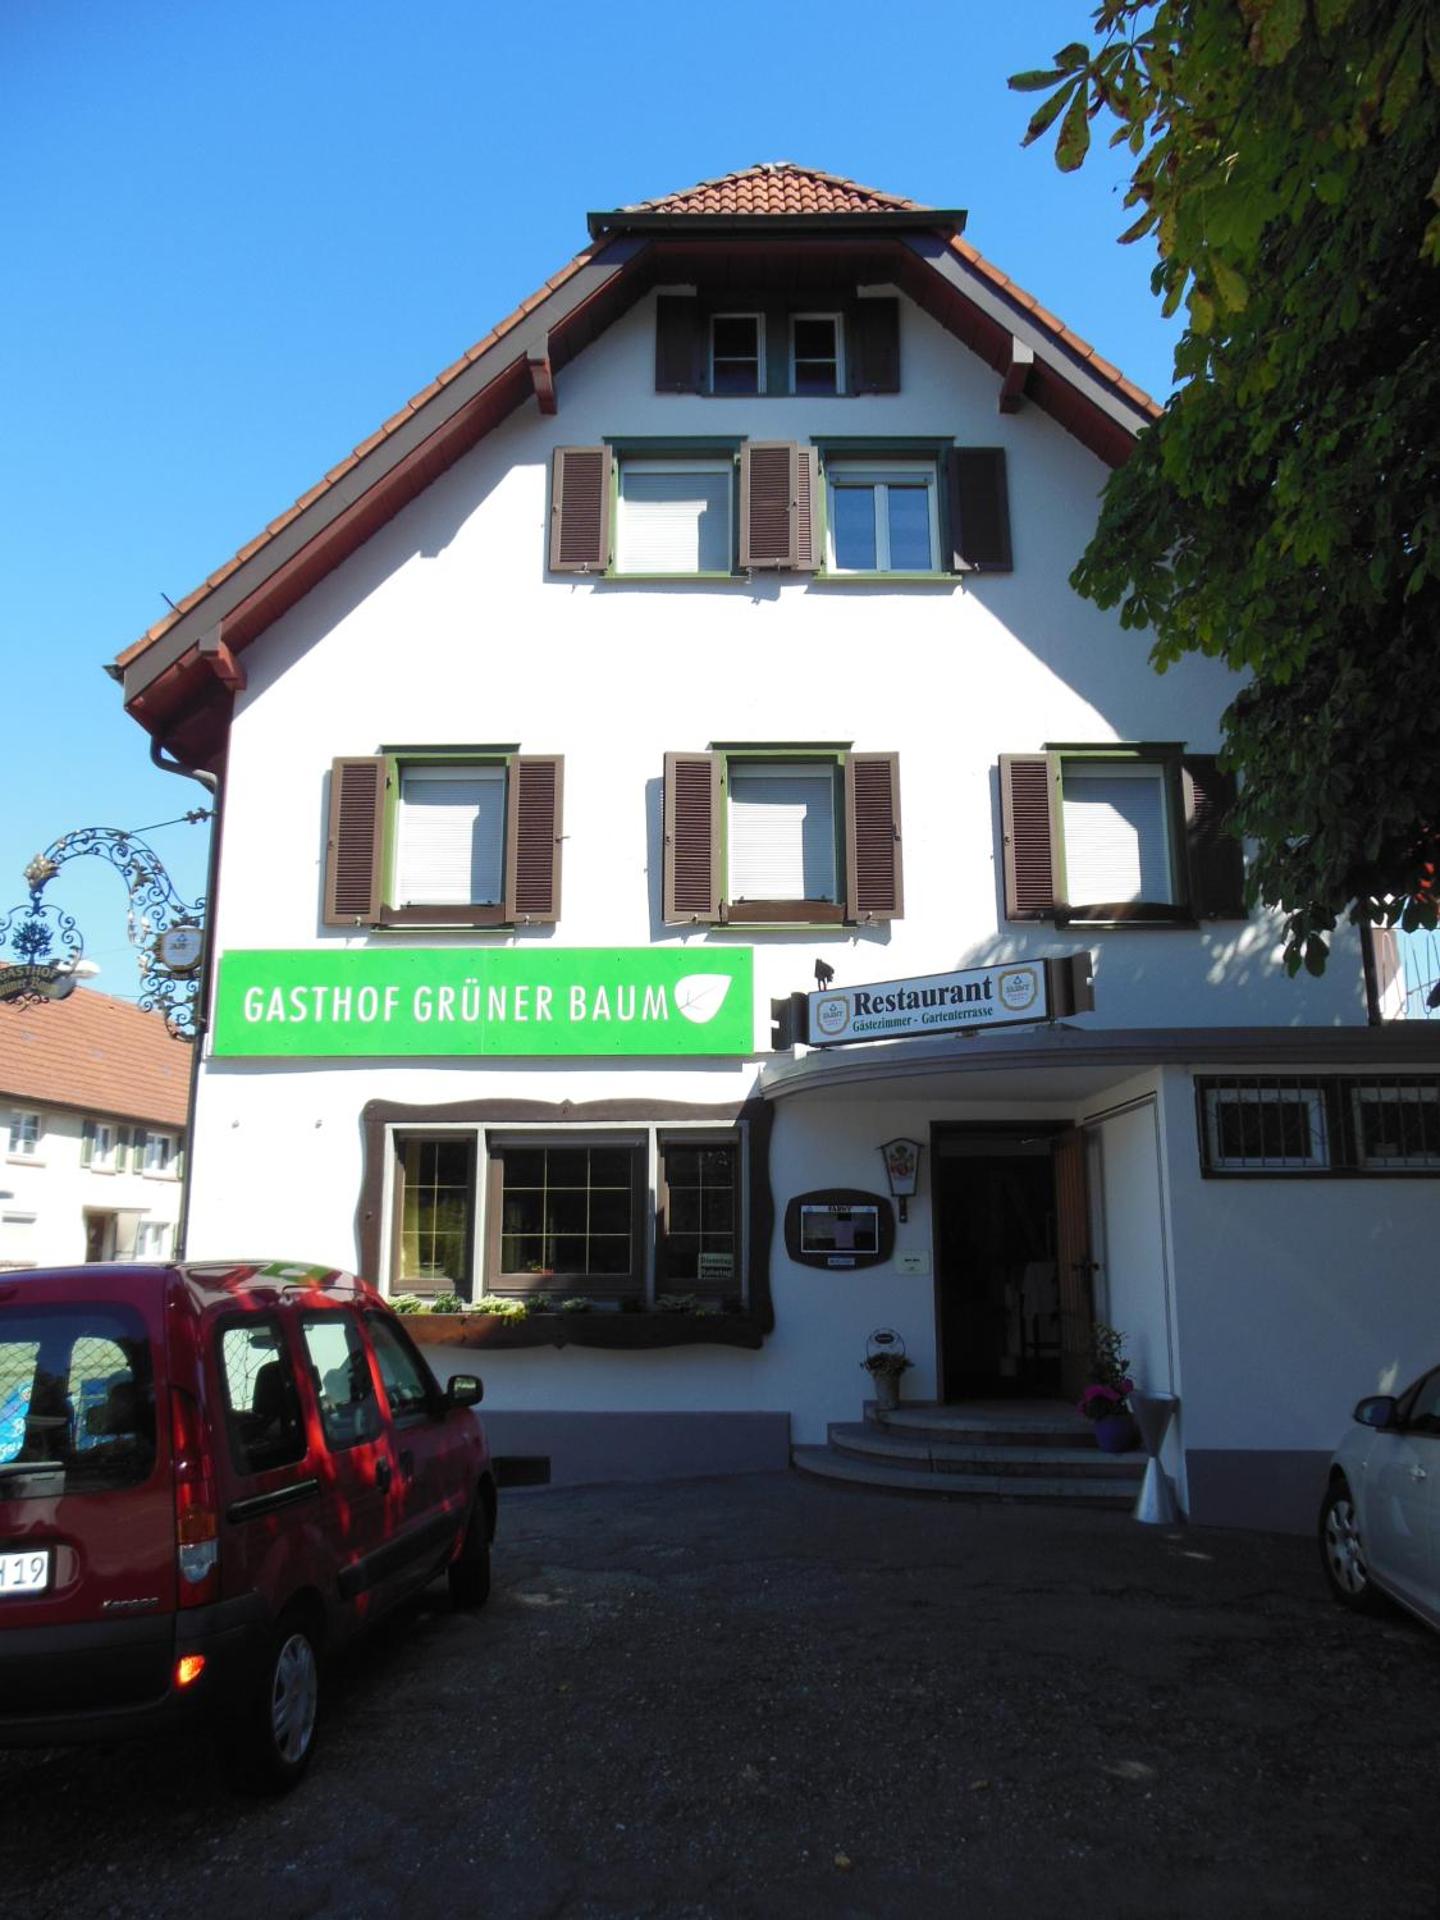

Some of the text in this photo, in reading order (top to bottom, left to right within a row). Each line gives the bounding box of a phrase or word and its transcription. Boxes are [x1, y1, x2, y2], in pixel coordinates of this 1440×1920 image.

[243, 977, 669, 1023] GASTHOF GRÜNER BAUM
[853, 975, 993, 1017] Restaurant
[852, 1015, 912, 1032] Gästezimmer
[921, 1006, 993, 1025] Gartenterrasse
